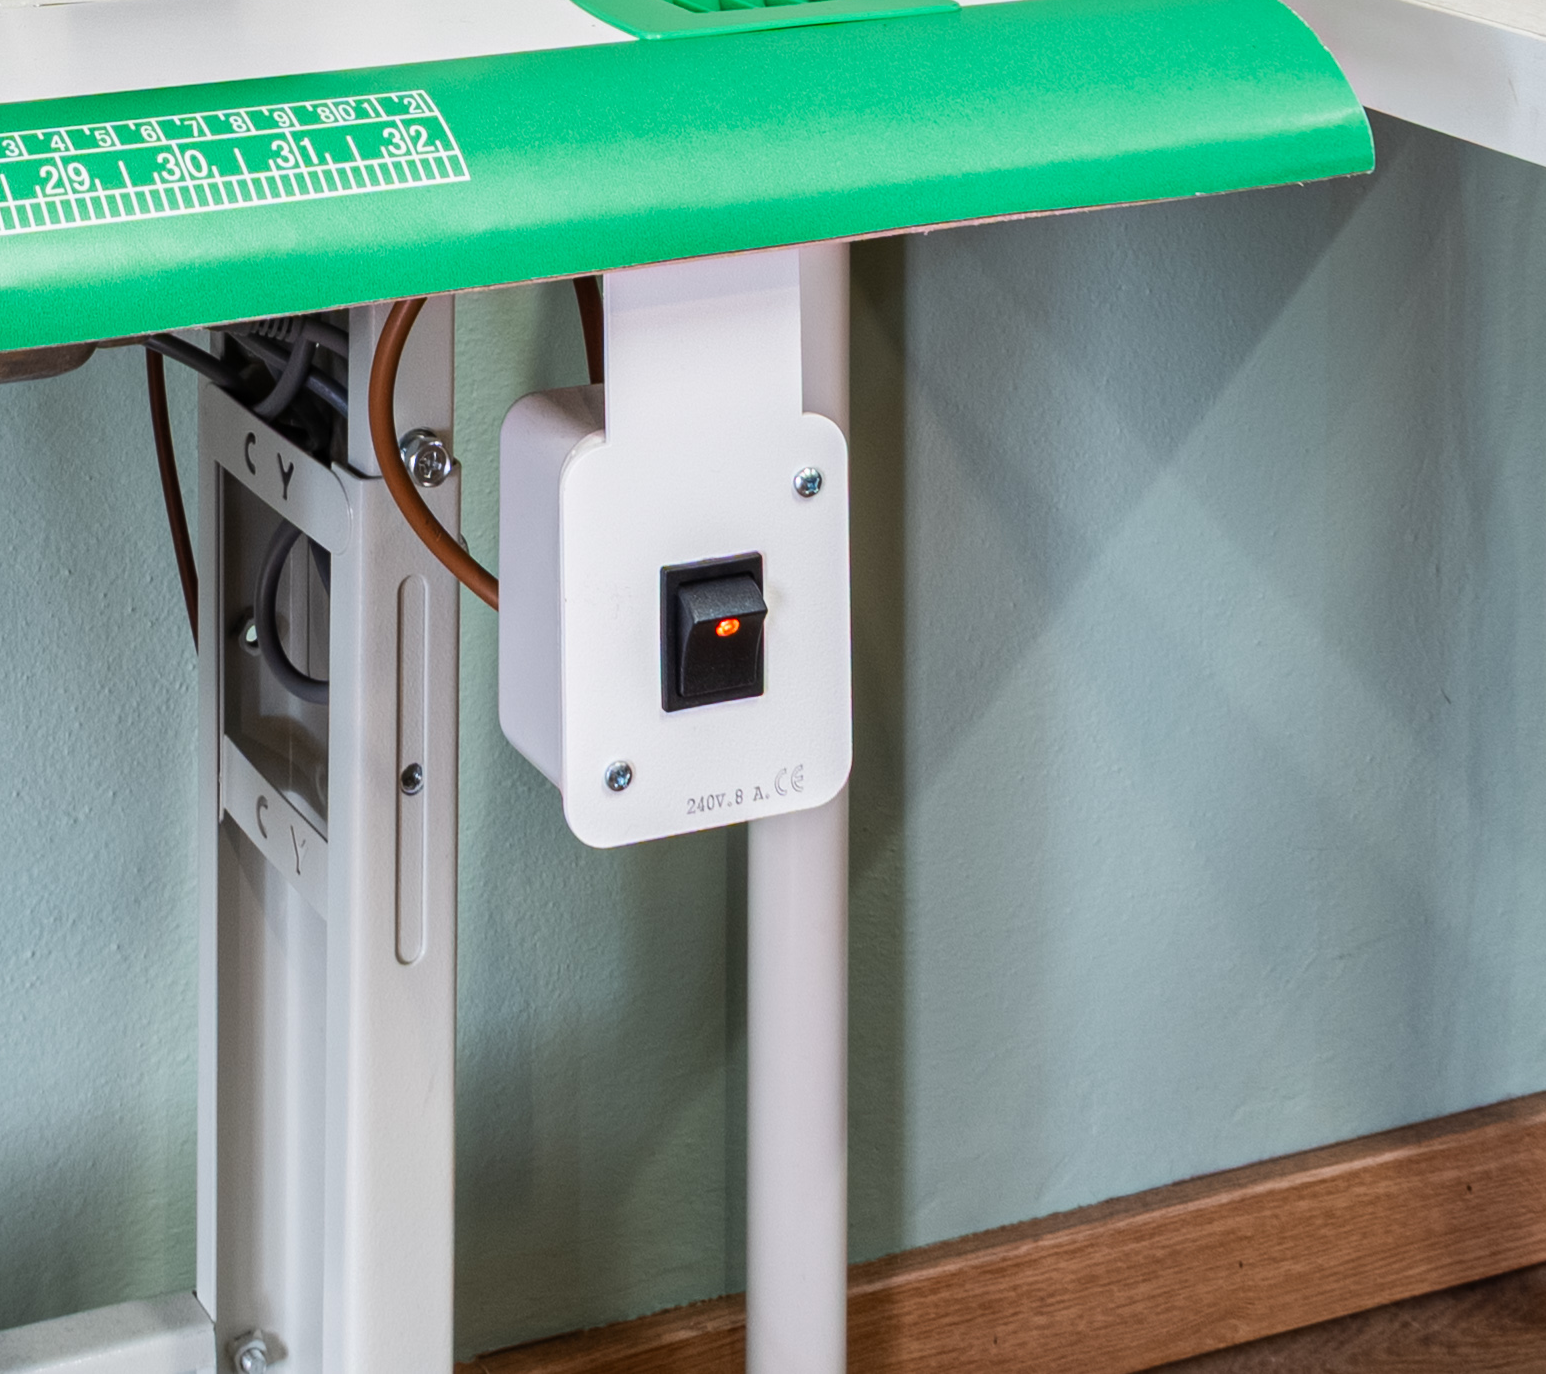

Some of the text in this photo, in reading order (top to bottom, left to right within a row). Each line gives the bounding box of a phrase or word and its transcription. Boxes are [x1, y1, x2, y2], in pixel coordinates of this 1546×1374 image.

[1, 138, 20, 158] 3
[50, 134, 67, 153] 4
[94, 129, 112, 148] 5
[140, 124, 158, 143] 6
[184, 119, 200, 139] 7
[228, 115, 248, 134] 8
[271, 110, 292, 130] 9
[403, 96, 423, 117] 2
[39, 162, 91, 197] 29
[157, 149, 208, 183] 30
[271, 137, 320, 170] 31
[382, 124, 435, 158] 32
[774, 764, 804, 796] CE
